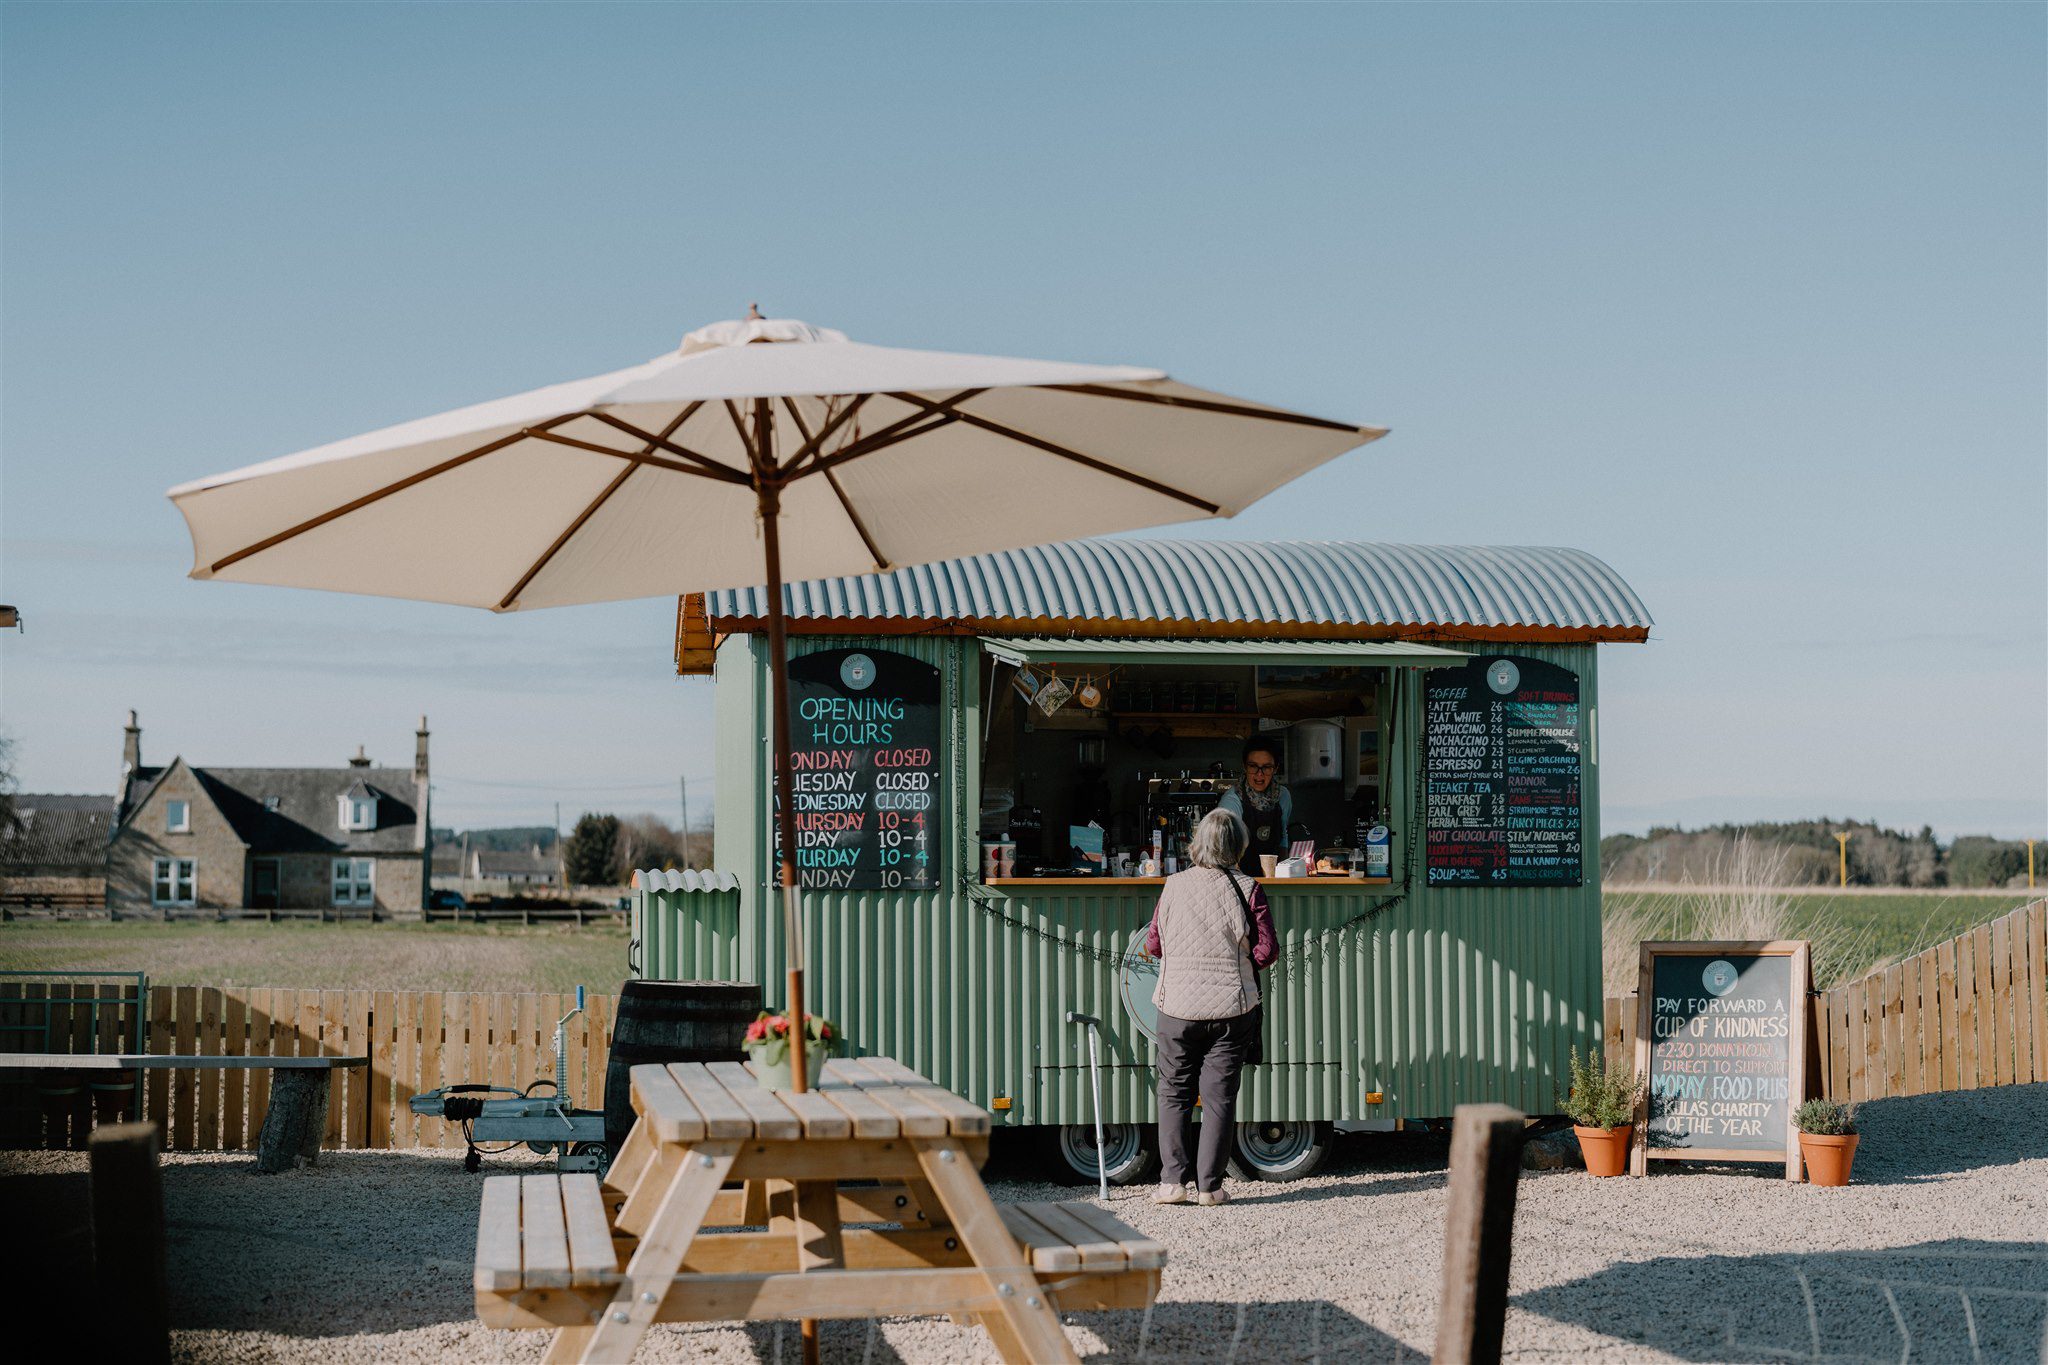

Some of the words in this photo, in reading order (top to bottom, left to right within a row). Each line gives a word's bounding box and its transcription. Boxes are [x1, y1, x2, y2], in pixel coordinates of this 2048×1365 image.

[1428, 687, 1468, 700] COFFEE
[1518, 690, 1540, 702] SOFT
[1542, 691, 1575, 702] DRINKS
[800, 697, 904, 721] OPENING
[1428, 701, 1459, 712] LATTE
[1428, 712, 1451, 723] FLAT
[1454, 712, 1482, 723] WHITE
[812, 723, 893, 745] HOURS
[1428, 724, 1486, 734] CAPPUCCINO
[1506, 728, 1575, 738] SUMMERHOUSE
[1428, 735, 1490, 746] MOCHACCINO
[1428, 746, 1486, 758] AMERICANO
[775, 750, 854, 770] ONDAY
[875, 748, 932, 768] CLOSED
[1428, 758, 1482, 770] ESPRESSO
[1508, 756, 1537, 765] ELGINS
[1538, 756, 1577, 764] ORCHARD
[774, 772, 856, 792] UESDAY
[876, 772, 930, 790] CLOSED
[1508, 776, 1547, 786] RADNOR
[1428, 782, 1470, 794] ETEAKET
[1472, 782, 1491, 794] TEA
[776, 793, 866, 811] EDNESDAY
[875, 792, 930, 810] CLOSED
[1428, 794, 1482, 806] BREAKFAST
[1428, 806, 1454, 818] EARL
[1456, 806, 1482, 817] GREY
[1508, 806, 1548, 816] STRATHMORE
[775, 812, 865, 832] HURSDAY
[1428, 817, 1462, 828] HERBAL
[1508, 816, 1534, 829] FANCY
[1536, 818, 1564, 829] PIECES
[775, 831, 840, 850] FIDAY
[1428, 830, 1450, 842] HOT
[1451, 830, 1506, 842] CHOCOLATE
[1428, 844, 1465, 856] LUXURY
[776, 848, 861, 868] STURDAY
[1510, 856, 1532, 866] KULA
[1532, 856, 1561, 866] KANDY
[776, 869, 856, 888] SNDAY
[1428, 868, 1457, 880] SOUP
[1656, 998, 1681, 1013] PAY
[1688, 998, 1766, 1014] FORWARD
[1775, 998, 1784, 1012] A
[1690, 1016, 1710, 1038] OF
[1699, 1042, 1774, 1058] DONATION
[1662, 1060, 1710, 1074] DIRECT
[1713, 1060, 1731, 1074] TO
[1734, 1060, 1788, 1074] SUPPORT
[1651, 1074, 1707, 1100] MORAY
[1712, 1076, 1752, 1100] FOOD
[1756, 1078, 1788, 1100] PLUS
[1664, 1100, 1708, 1117] KULA'S
[1711, 1102, 1772, 1118] CHARITY
[1685, 1117, 1714, 1134] THE
[1720, 1118, 1764, 1136] YEAR
